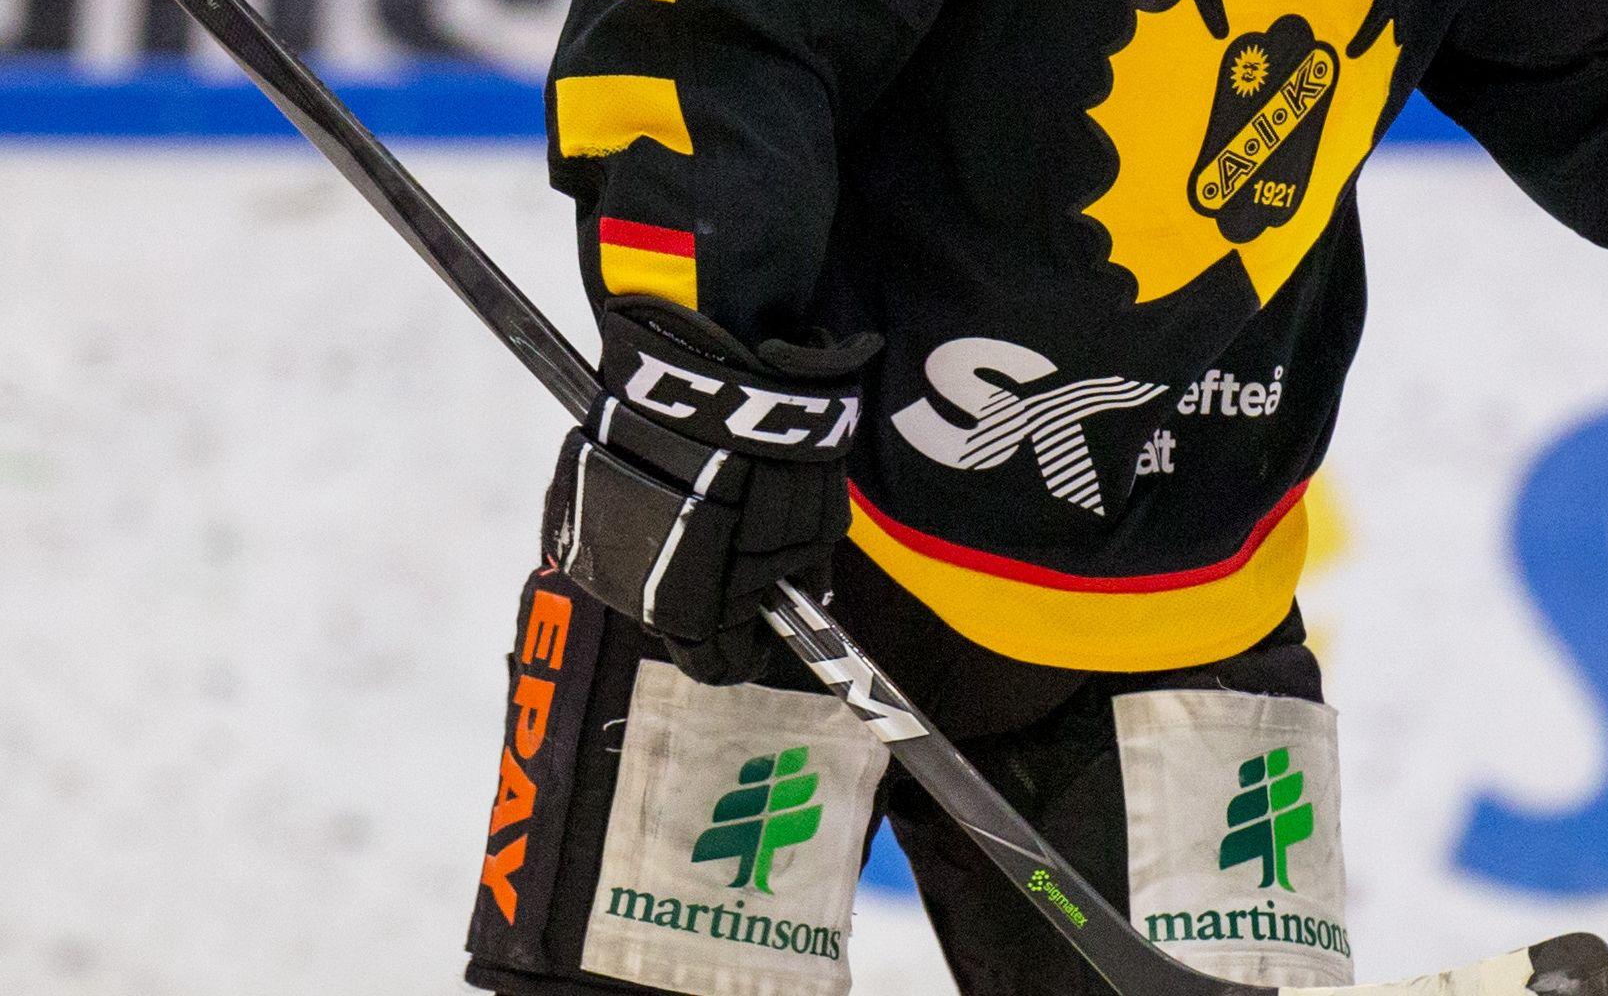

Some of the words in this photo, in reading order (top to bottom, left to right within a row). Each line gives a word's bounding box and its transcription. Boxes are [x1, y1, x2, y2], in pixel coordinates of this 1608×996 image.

[1252, 180, 1297, 208] 1921
[479, 589, 573, 926] EPAY
[606, 885, 841, 961] martinsons
[1042, 879, 1088, 930] sigmatex
[1144, 899, 1351, 958] martinsons
